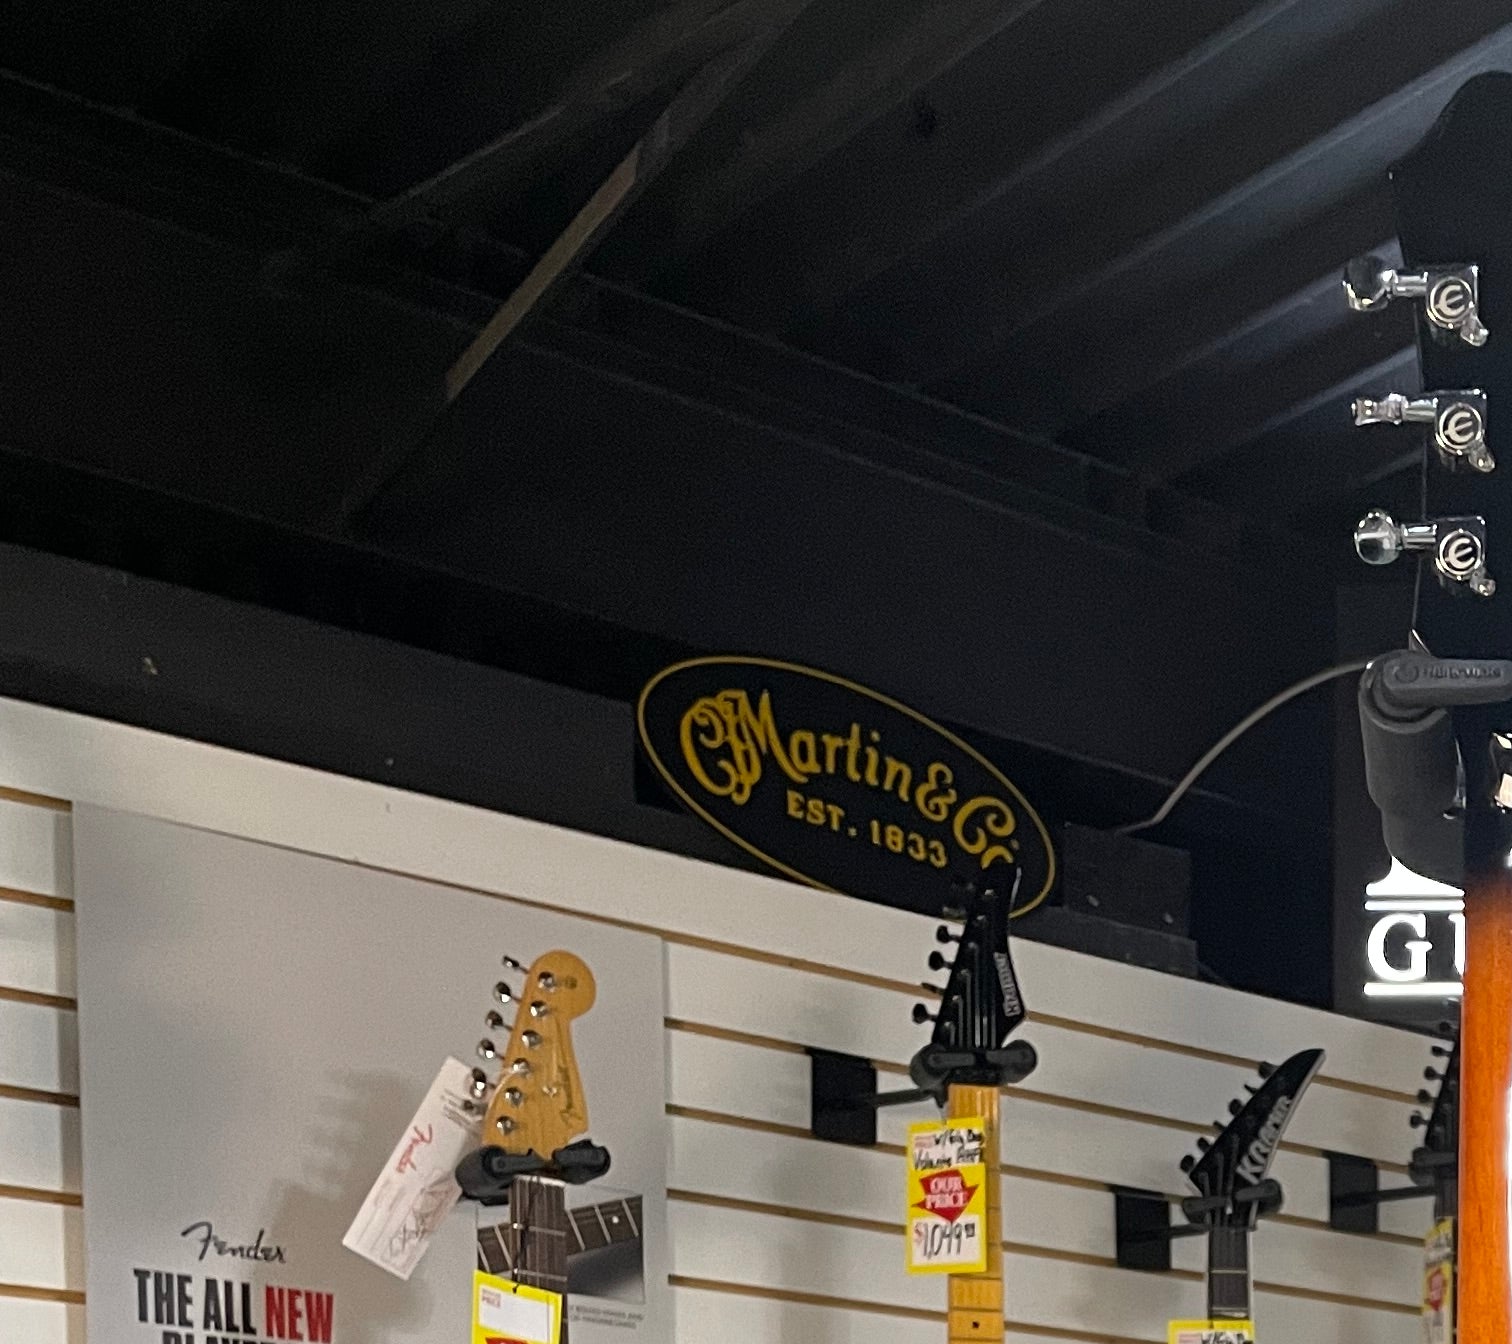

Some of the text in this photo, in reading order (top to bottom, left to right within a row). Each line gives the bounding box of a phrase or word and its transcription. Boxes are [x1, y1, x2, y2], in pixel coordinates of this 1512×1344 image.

[786, 789, 948, 869] EST. 1833
[181, 1221, 287, 1264] Fender
[133, 1268, 334, 1344] THE ALL NEW
